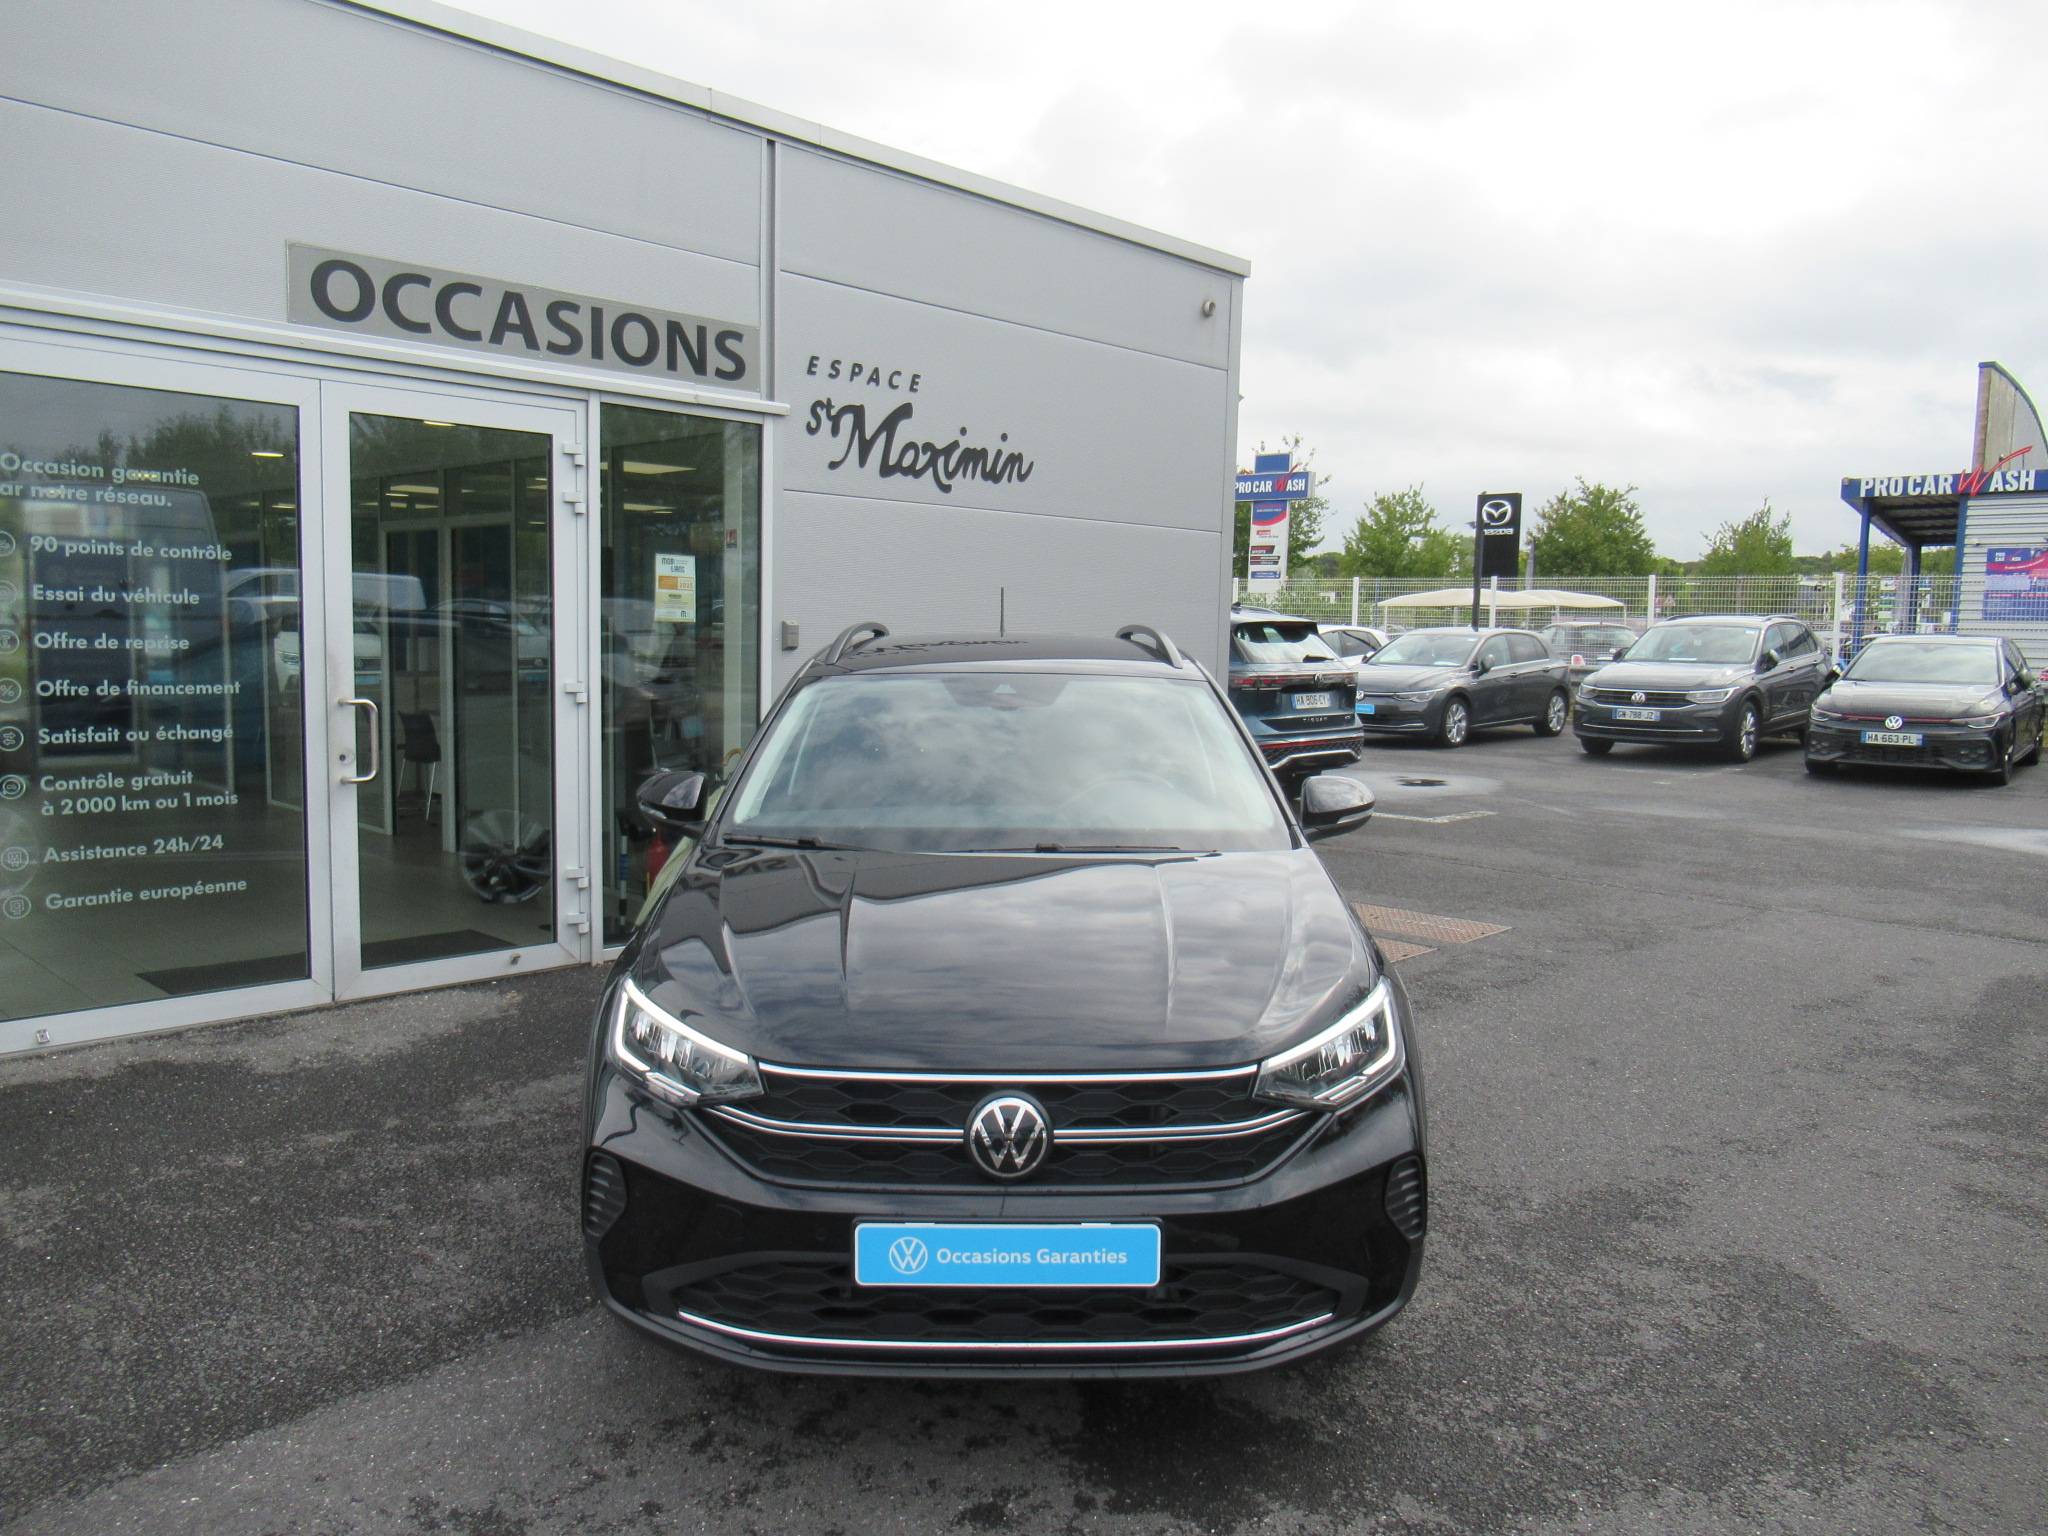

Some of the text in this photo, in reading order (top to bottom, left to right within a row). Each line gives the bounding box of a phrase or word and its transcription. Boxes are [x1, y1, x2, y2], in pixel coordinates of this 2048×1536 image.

[310, 259, 746, 381] OCCASIONS
[806, 355, 921, 393] ESPACE
[828, 402, 1034, 494] Maximin
[0, 452, 200, 486] Occasion garantie
[1860, 446, 2035, 497] PRO CAR WASH
[0, 483, 172, 507] ar notre réseau.
[1253, 480, 1272, 493] CAR
[30, 535, 232, 560] 90 points de contrôle
[32, 584, 200, 605] Essai du véhicule
[34, 632, 190, 654] Offre de reprise
[36, 679, 241, 697] Offre de financement
[38, 724, 233, 745] Satisfait ou échangé
[40, 770, 194, 792] Contrôle gratuit
[41, 801, 54, 816] à
[122, 795, 150, 811] km
[155, 797, 178, 810] ou
[196, 791, 238, 806] mois
[43, 834, 224, 864] Assistance 24h/24
[46, 880, 247, 910] Garantie européenne
[937, 1248, 1031, 1265] Occasions
[1036, 1248, 1128, 1265] Garanties
